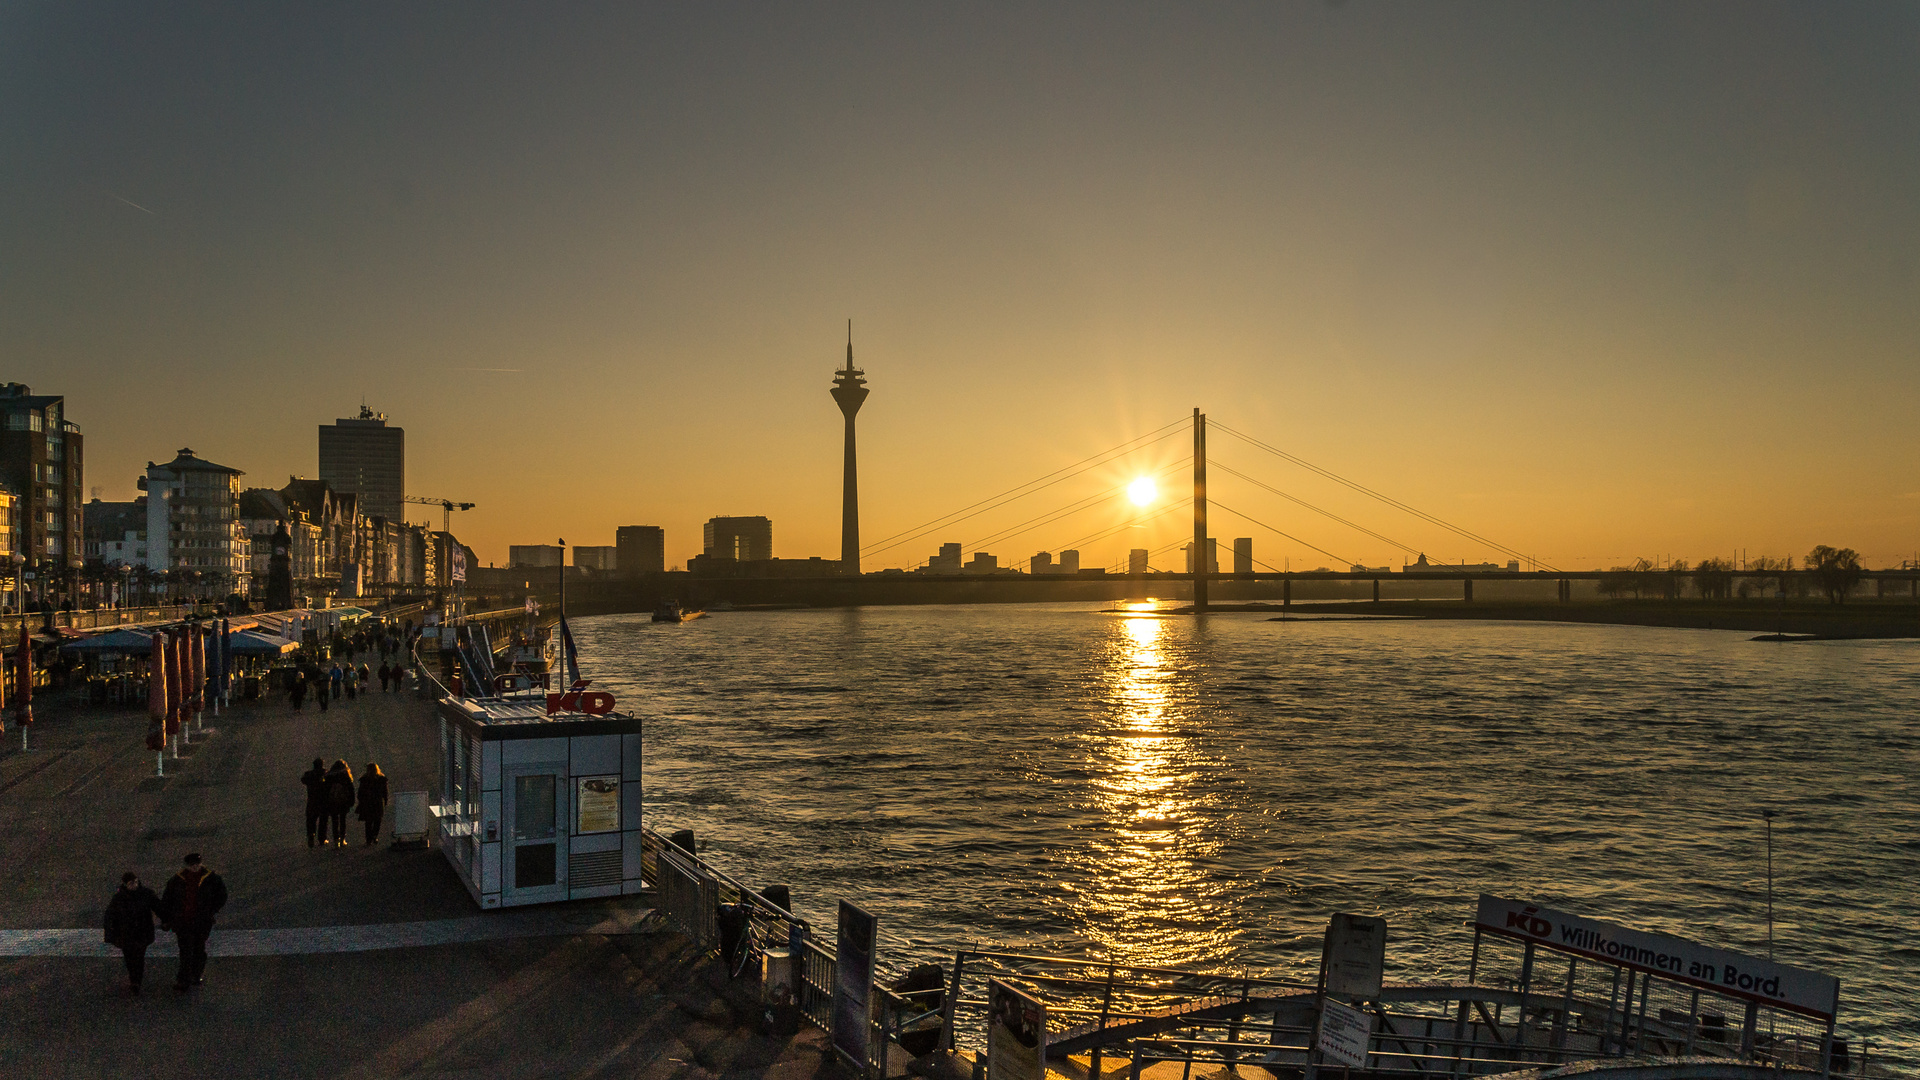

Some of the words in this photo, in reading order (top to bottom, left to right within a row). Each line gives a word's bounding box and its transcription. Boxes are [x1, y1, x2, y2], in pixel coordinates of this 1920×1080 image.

[547, 680, 616, 716] KD
[1506, 907, 1552, 938] KD
[1561, 924, 1682, 973] Willkommen
[1689, 961, 1715, 981] an
[1723, 965, 1786, 998] Bord.
